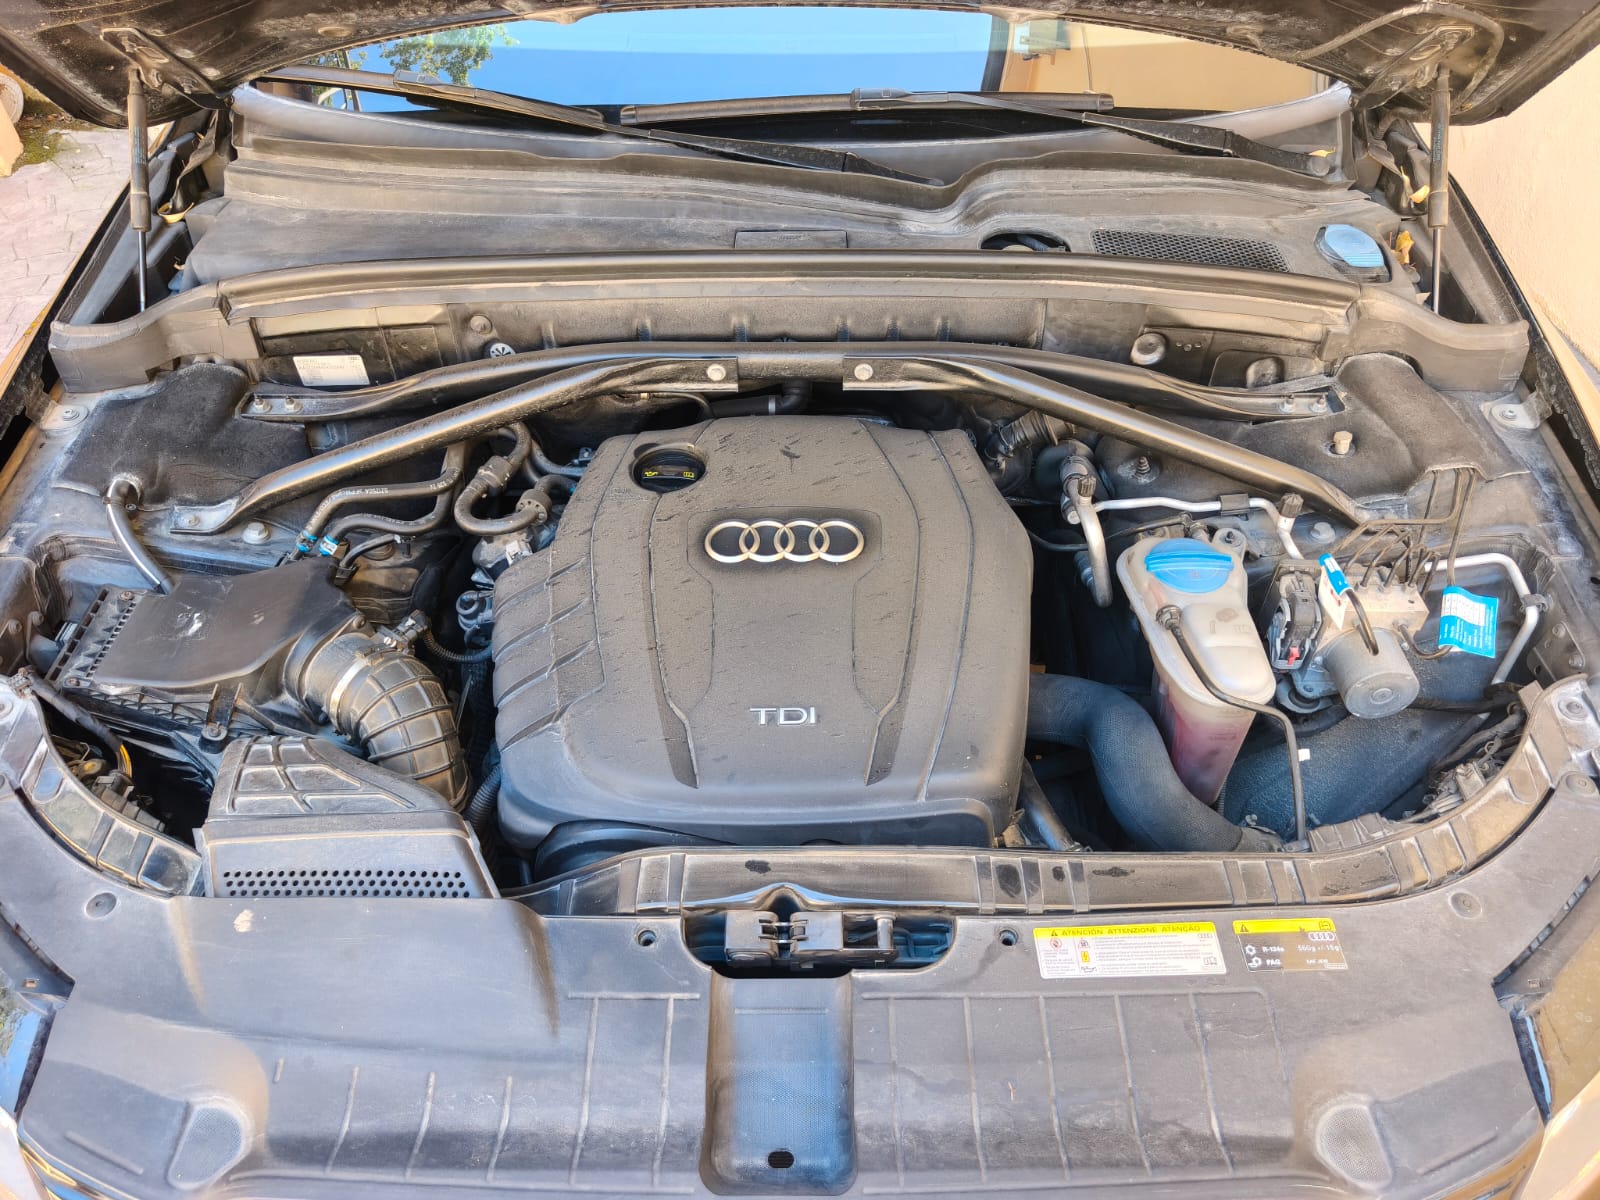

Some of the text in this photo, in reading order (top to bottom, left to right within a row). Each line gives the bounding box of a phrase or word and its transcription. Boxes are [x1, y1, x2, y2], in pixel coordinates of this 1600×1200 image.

[749, 706, 816, 725] TDI
[1061, 928, 1104, 936] ATENCIÓN
[1107, 926, 1157, 935] ATTENZIONE
